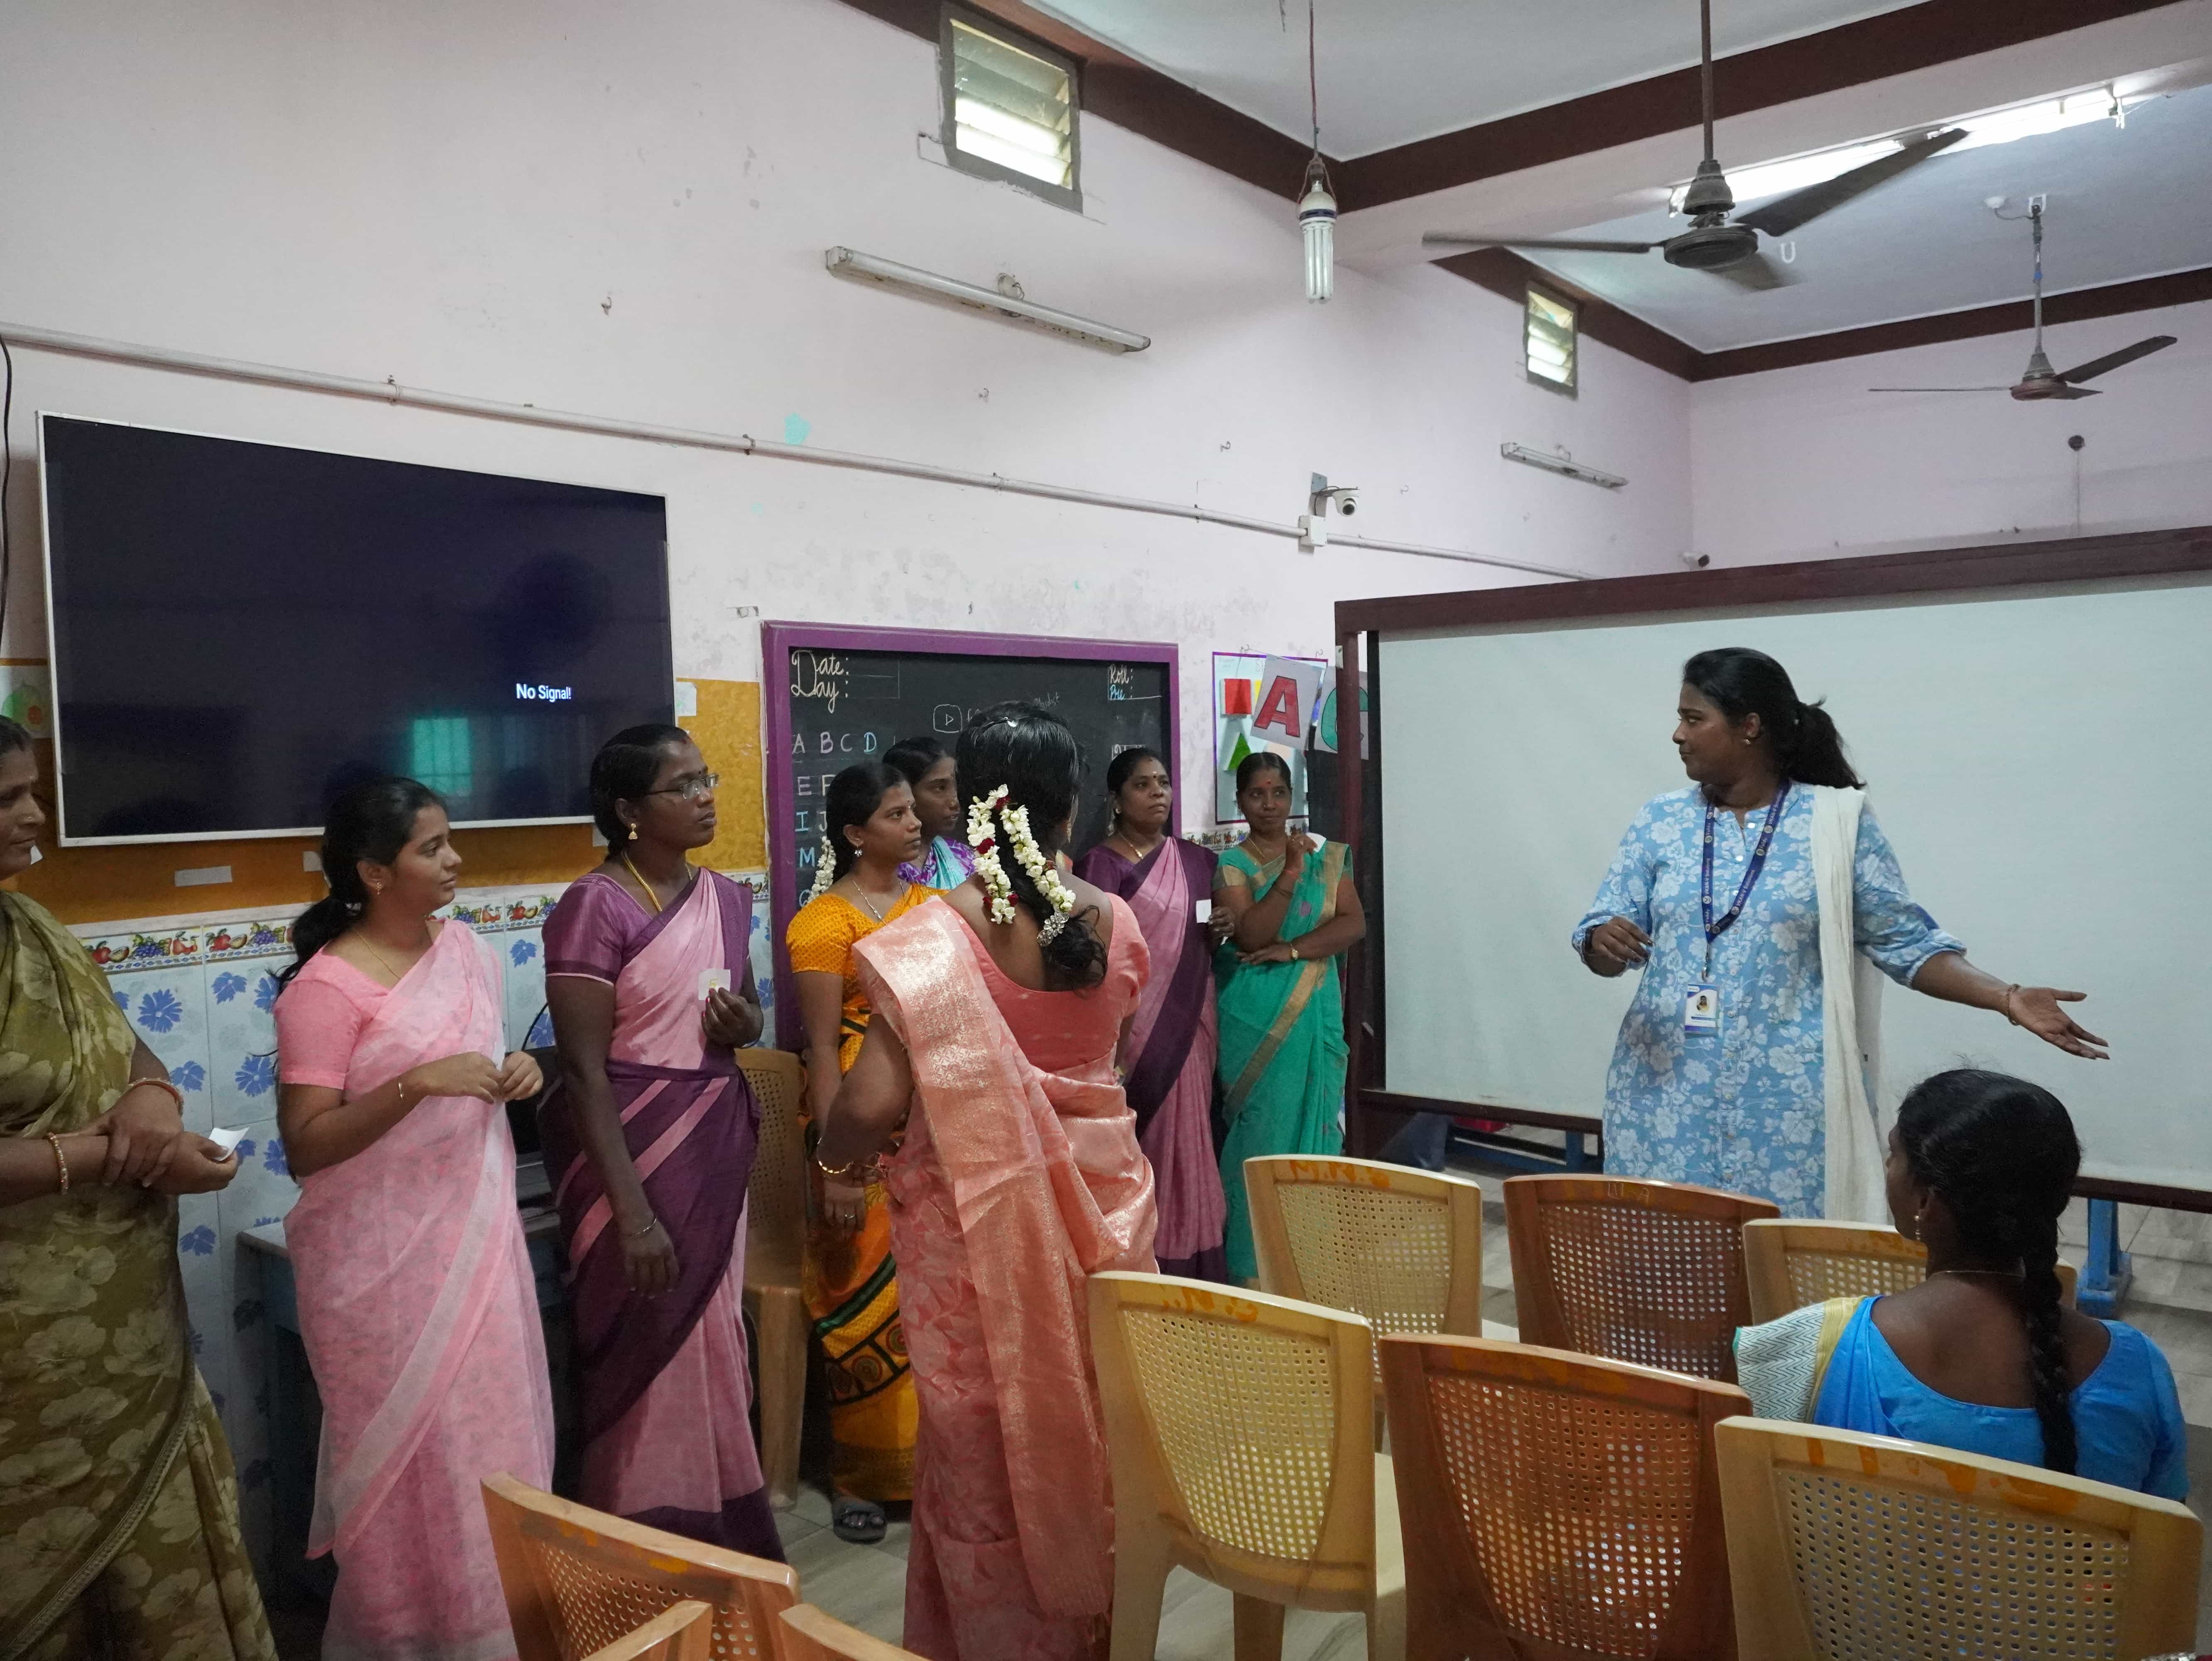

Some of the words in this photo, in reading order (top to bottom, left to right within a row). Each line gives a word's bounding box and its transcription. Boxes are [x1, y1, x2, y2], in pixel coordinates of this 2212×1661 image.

[516, 684, 536, 699] No
[538, 685, 571, 702] Signal!
[1254, 675, 1300, 738] A
[792, 733, 806, 755] A
[820, 731, 834, 754] B
[840, 733, 852, 752] C
[863, 731, 877, 755] D
[797, 776, 812, 796] E
[799, 847, 815, 868] M
